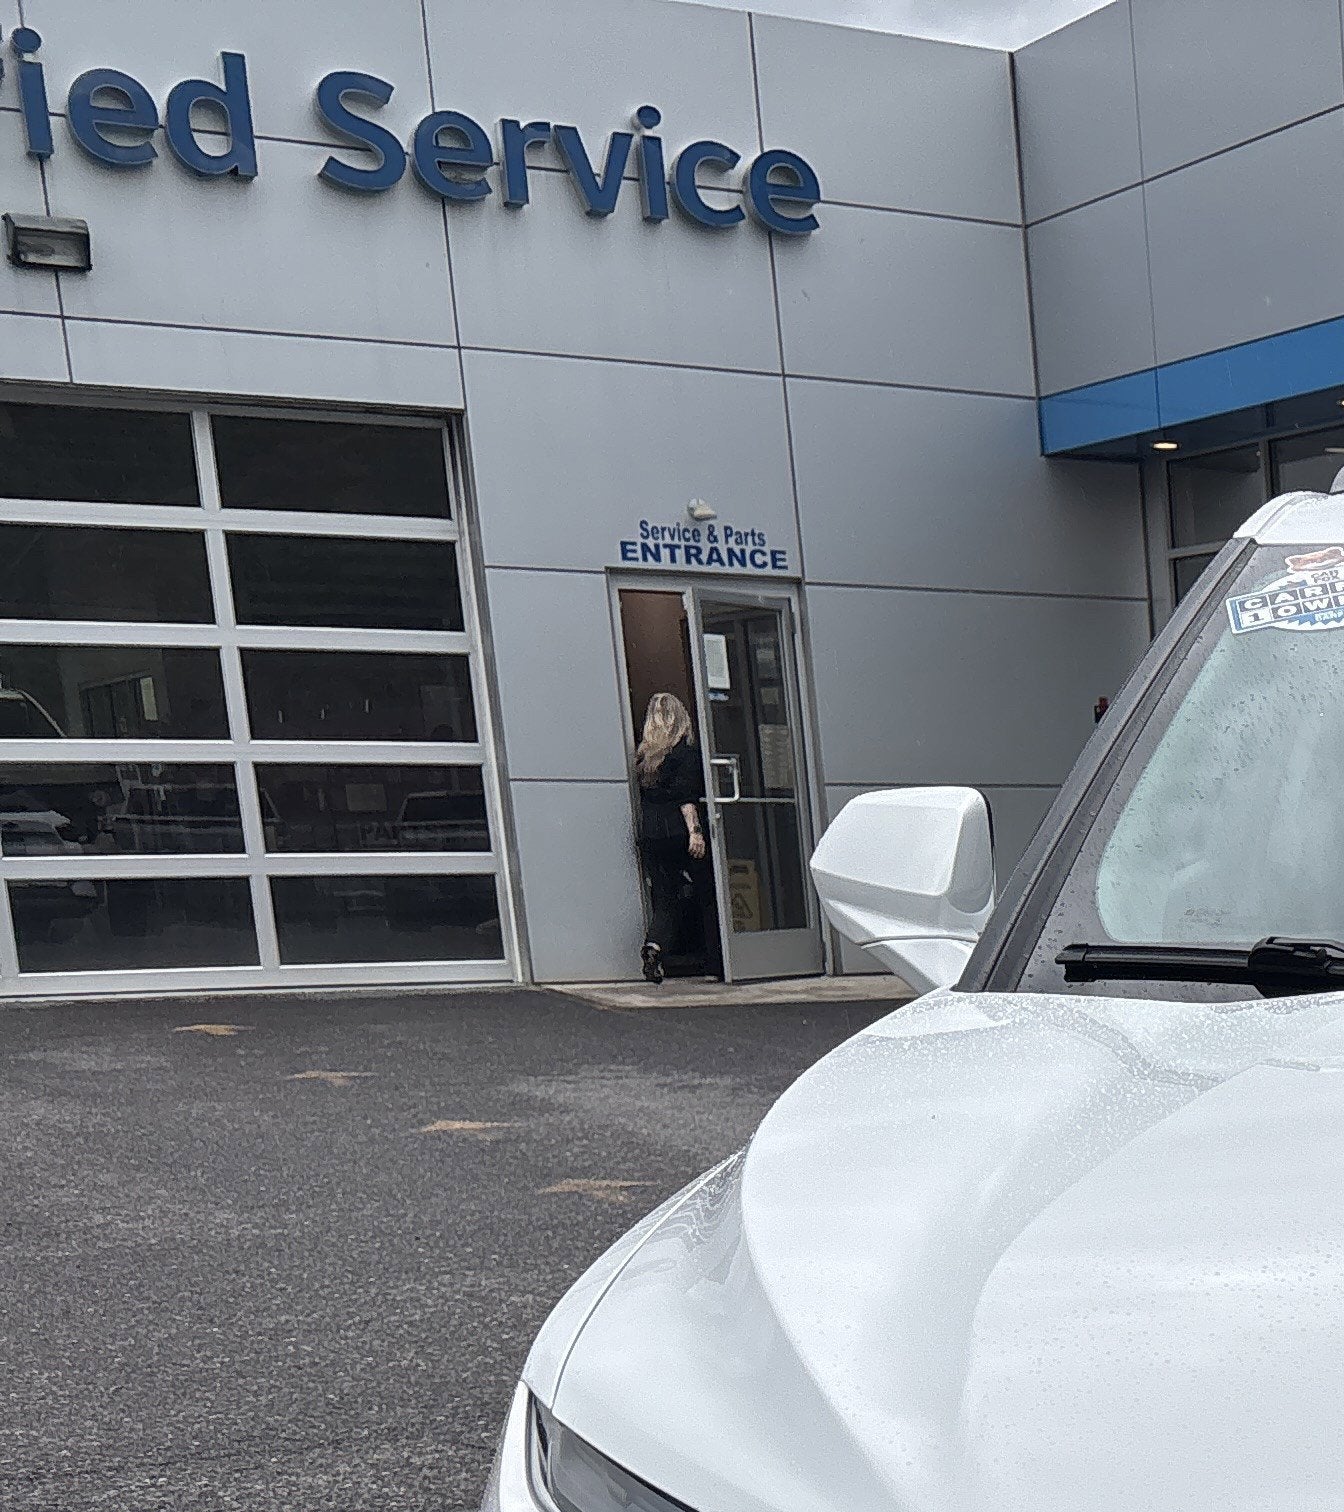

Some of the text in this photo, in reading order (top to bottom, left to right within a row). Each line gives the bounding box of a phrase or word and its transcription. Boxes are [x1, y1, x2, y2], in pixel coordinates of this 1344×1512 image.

[0, 26, 822, 236] ied Service
[639, 519, 767, 547] Service & Parts
[619, 541, 789, 570] ENTRANCE
[1248, 612, 1265, 623] 1
